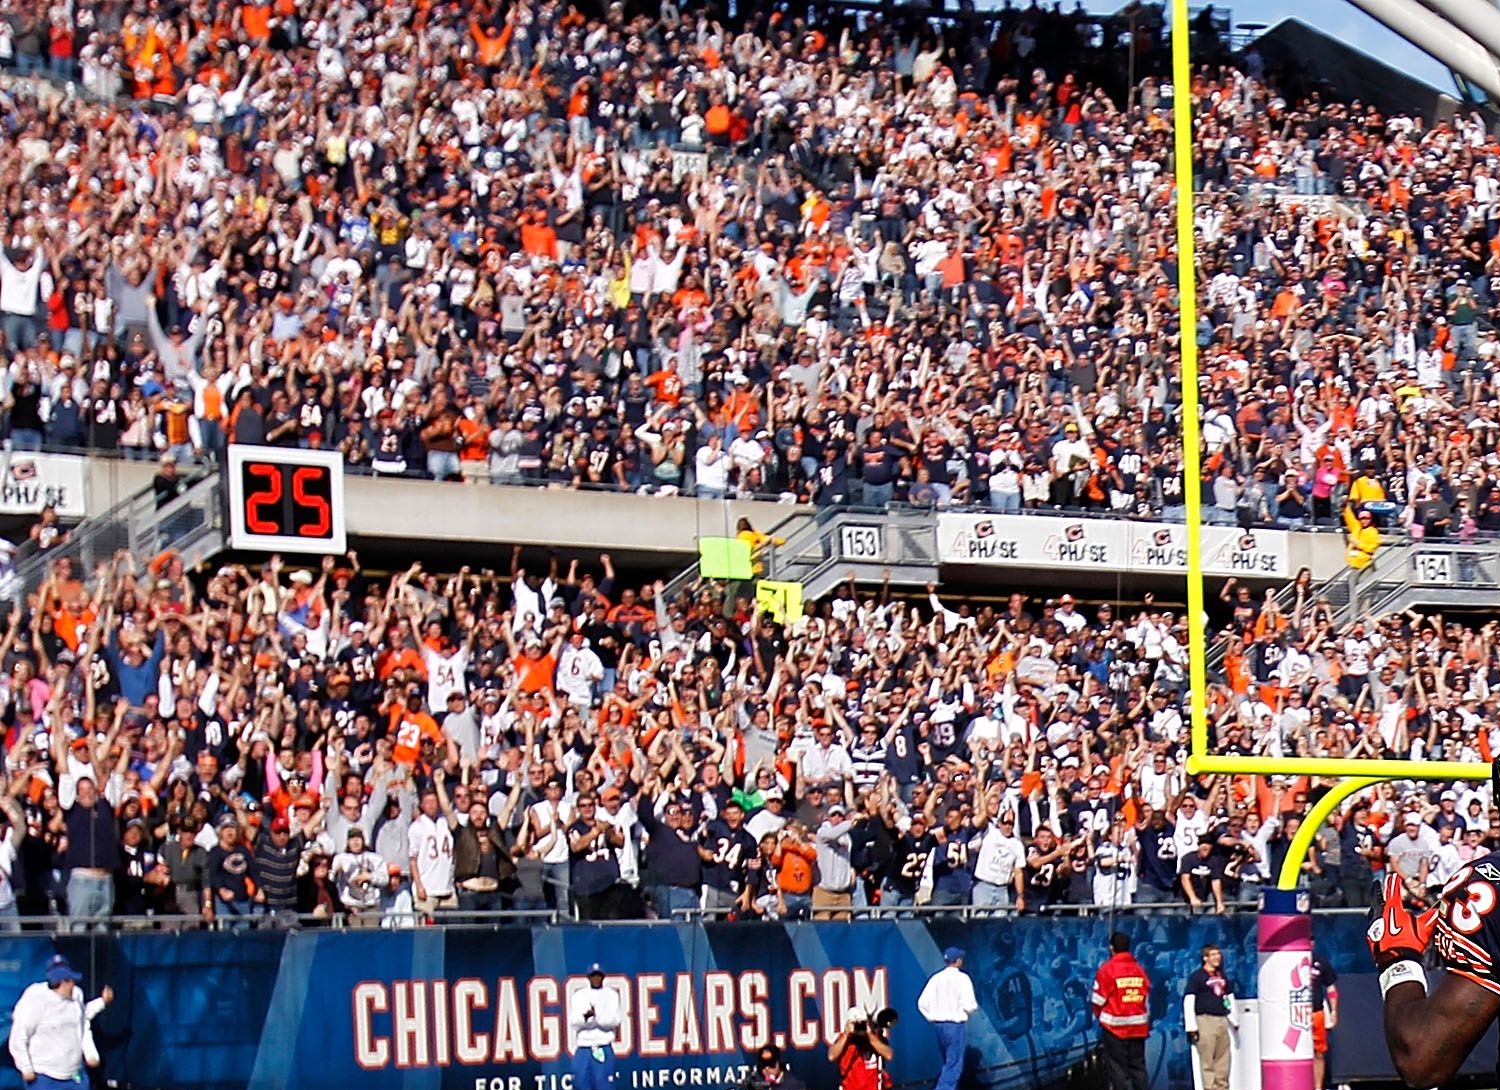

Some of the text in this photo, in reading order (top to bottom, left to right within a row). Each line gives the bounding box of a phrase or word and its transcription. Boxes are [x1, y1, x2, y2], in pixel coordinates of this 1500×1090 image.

[246, 464, 330, 536] 25
[846, 530, 876, 557] 153
[1420, 556, 1447, 581] 154
[436, 665, 455, 685] 54
[570, 657, 579, 676] 6
[397, 720, 419, 748] 23
[896, 735, 905, 757] 8
[1079, 809, 1109, 837] 34
[426, 836, 453, 860] 34
[712, 836, 740, 868] 34
